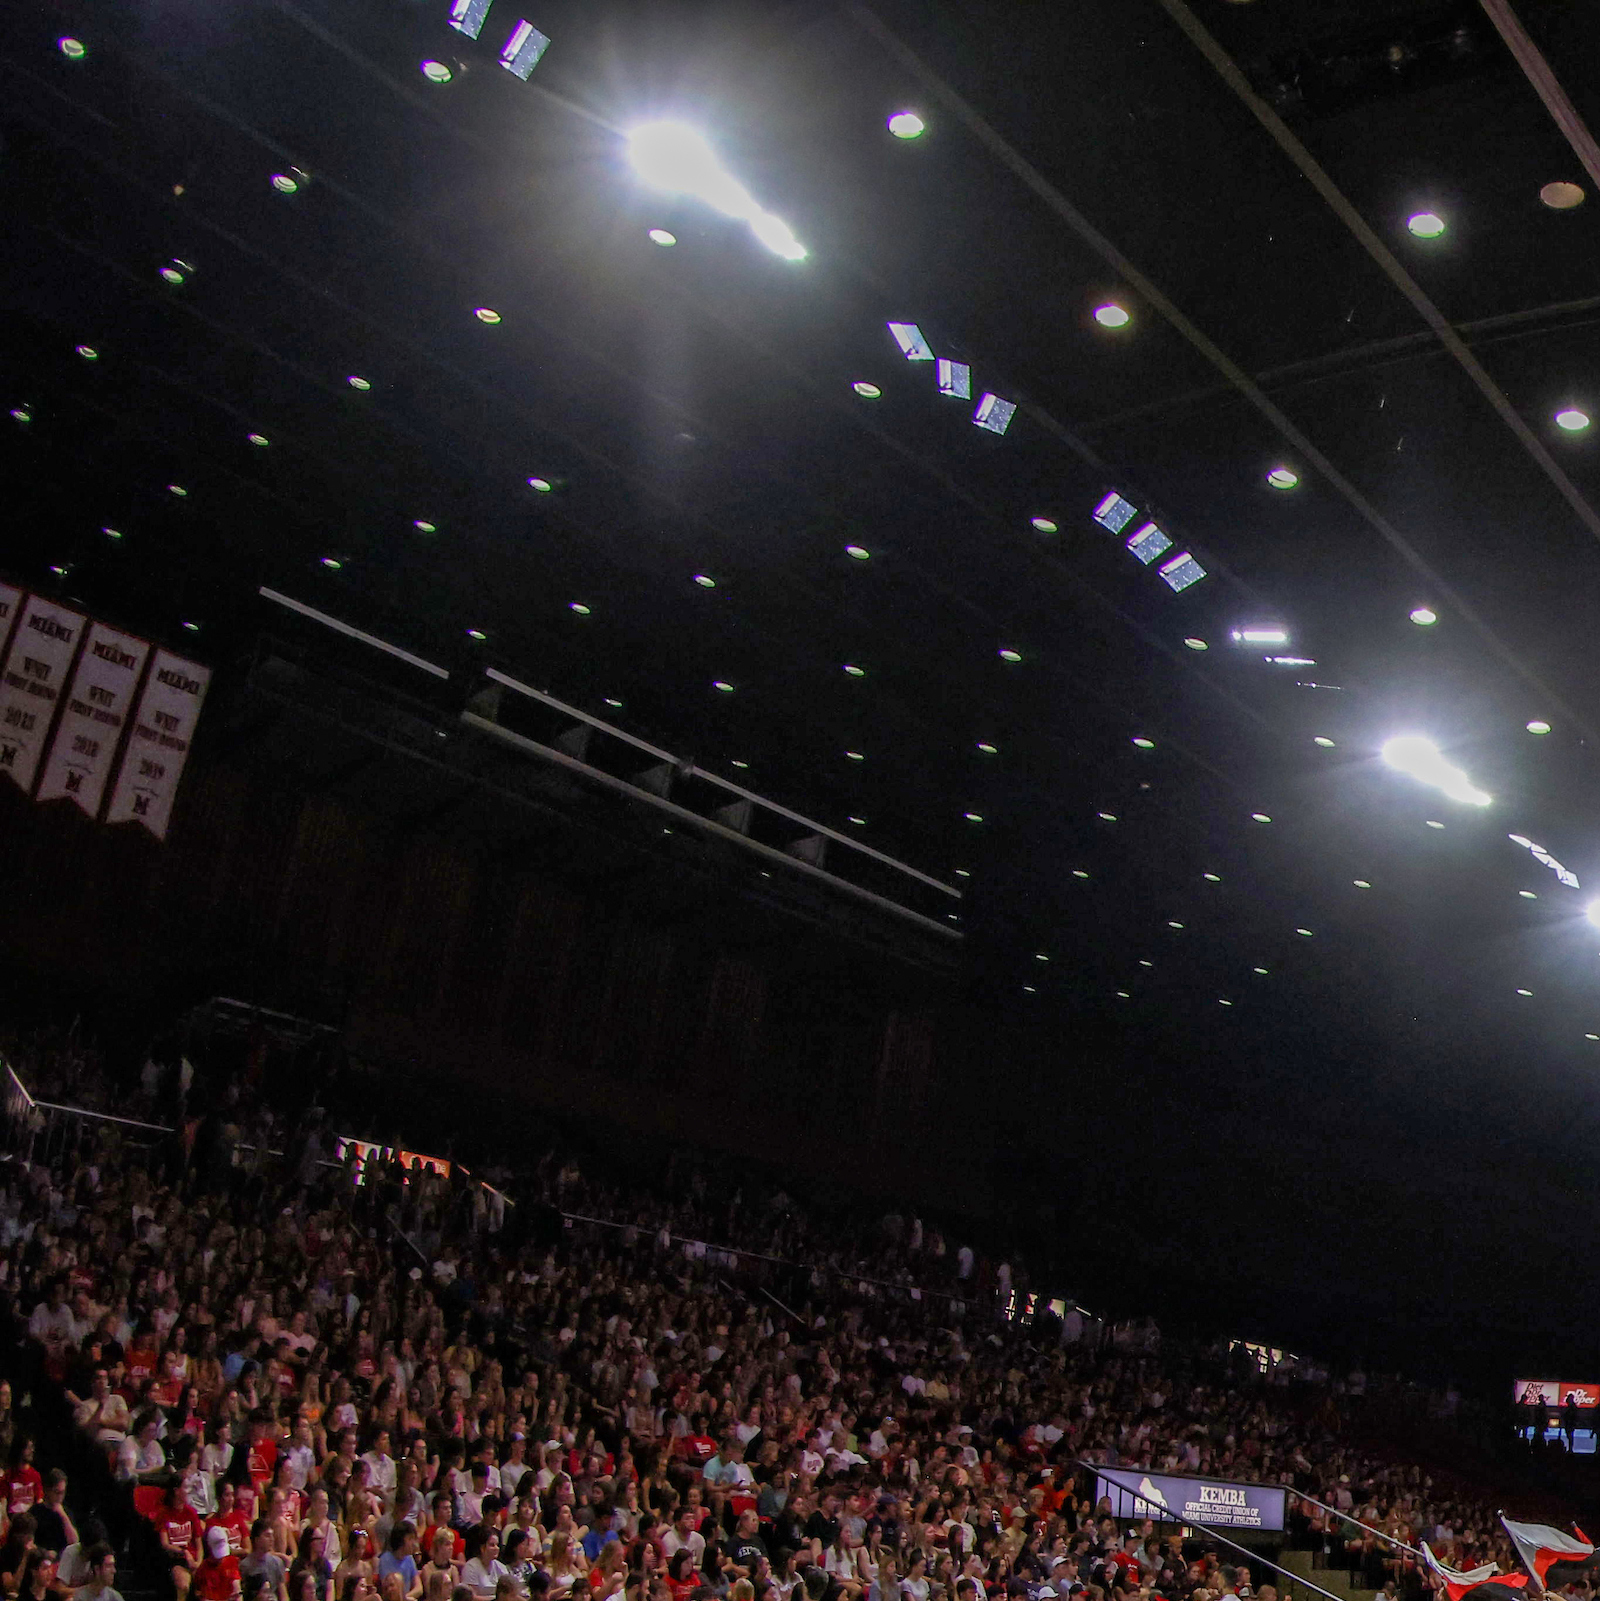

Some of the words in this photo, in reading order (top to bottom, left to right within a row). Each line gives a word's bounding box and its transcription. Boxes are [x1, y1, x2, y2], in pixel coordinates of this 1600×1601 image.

[1575, 1389, 1588, 1397] Dr
[1200, 1486, 1246, 1506] KEMBA
[1185, 1502, 1212, 1513] OFFICIAL
[1211, 1505, 1232, 1515] CREDIT
[1232, 1506, 1250, 1516] UNION
[1250, 1508, 1260, 1517] OF
[1182, 1511, 1200, 1521] MIAMI
[1200, 1512, 1232, 1524] UNIVERSITY
[1232, 1515, 1261, 1526] ATHLETICS
